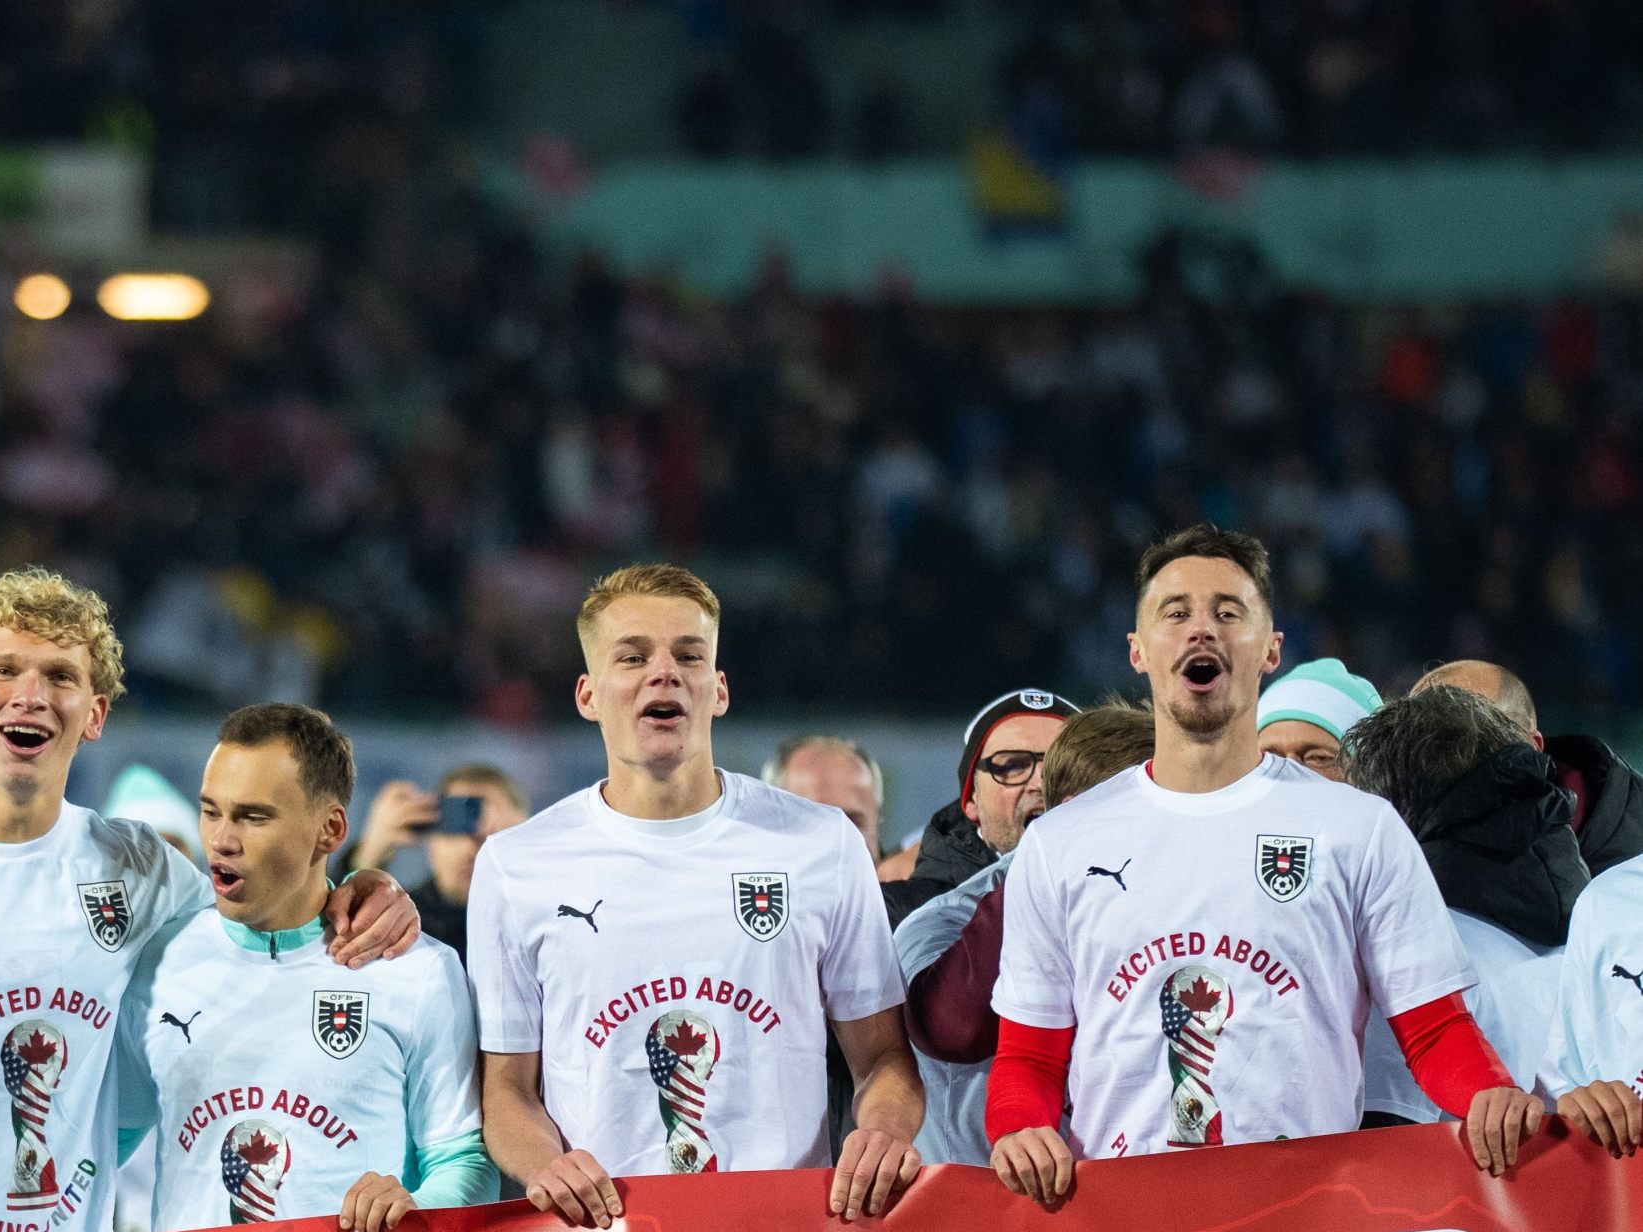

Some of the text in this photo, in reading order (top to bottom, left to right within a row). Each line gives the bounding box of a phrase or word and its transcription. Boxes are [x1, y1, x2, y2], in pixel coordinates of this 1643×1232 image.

[1107, 931, 1299, 1002] EXCITED ABOUT
[49, 987, 112, 1030] ABOU
[585, 976, 782, 1049] EXCITED ABOUT
[177, 1086, 359, 1153] EXCITED ABOUT
